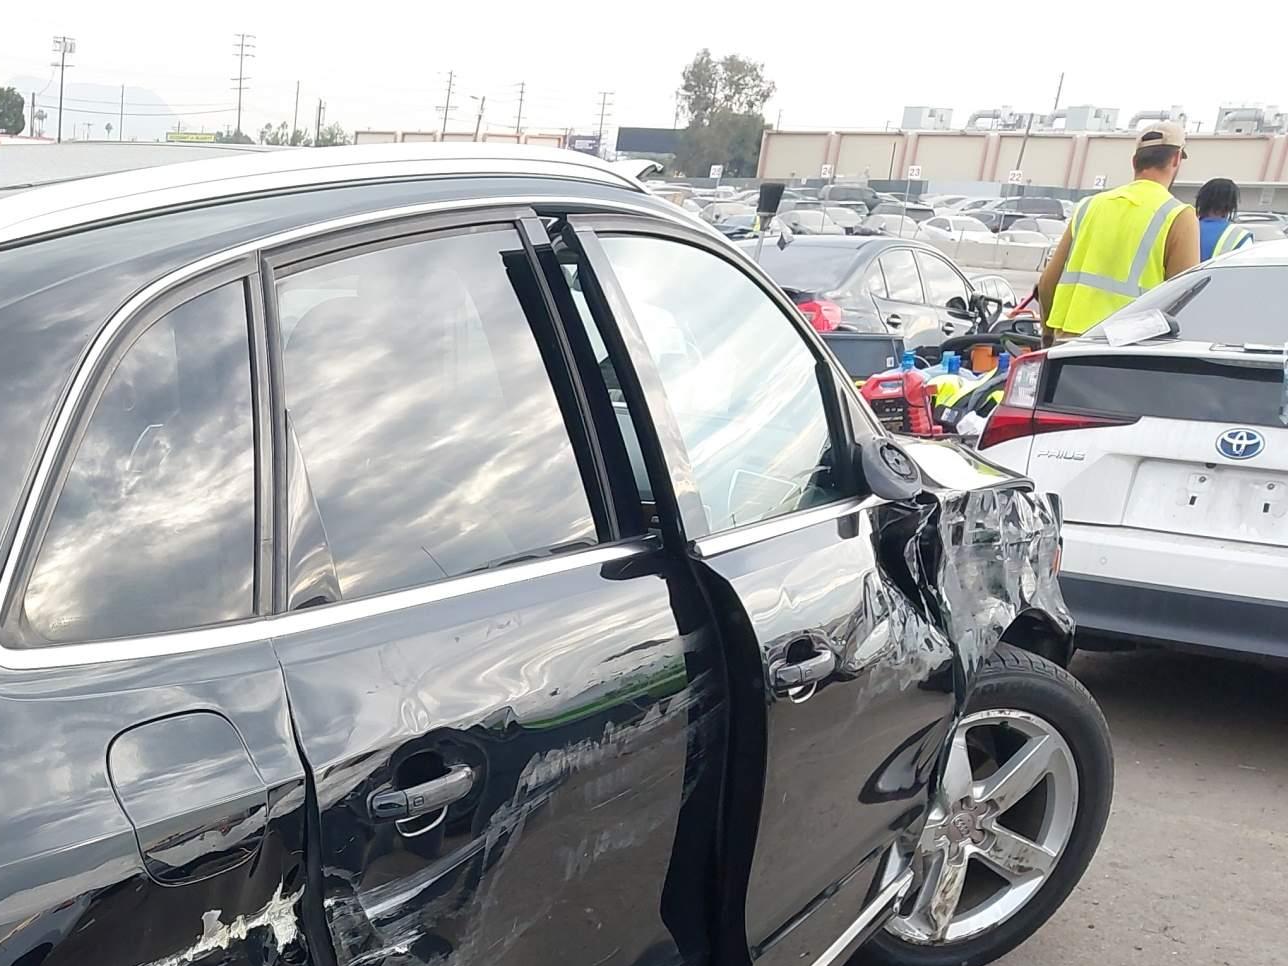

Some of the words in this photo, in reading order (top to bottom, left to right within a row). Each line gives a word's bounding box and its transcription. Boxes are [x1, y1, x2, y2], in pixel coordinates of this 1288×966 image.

[909, 168, 921, 178] 23
[1009, 173, 1022, 183] 22
[1037, 447, 1086, 461] PRIUS
